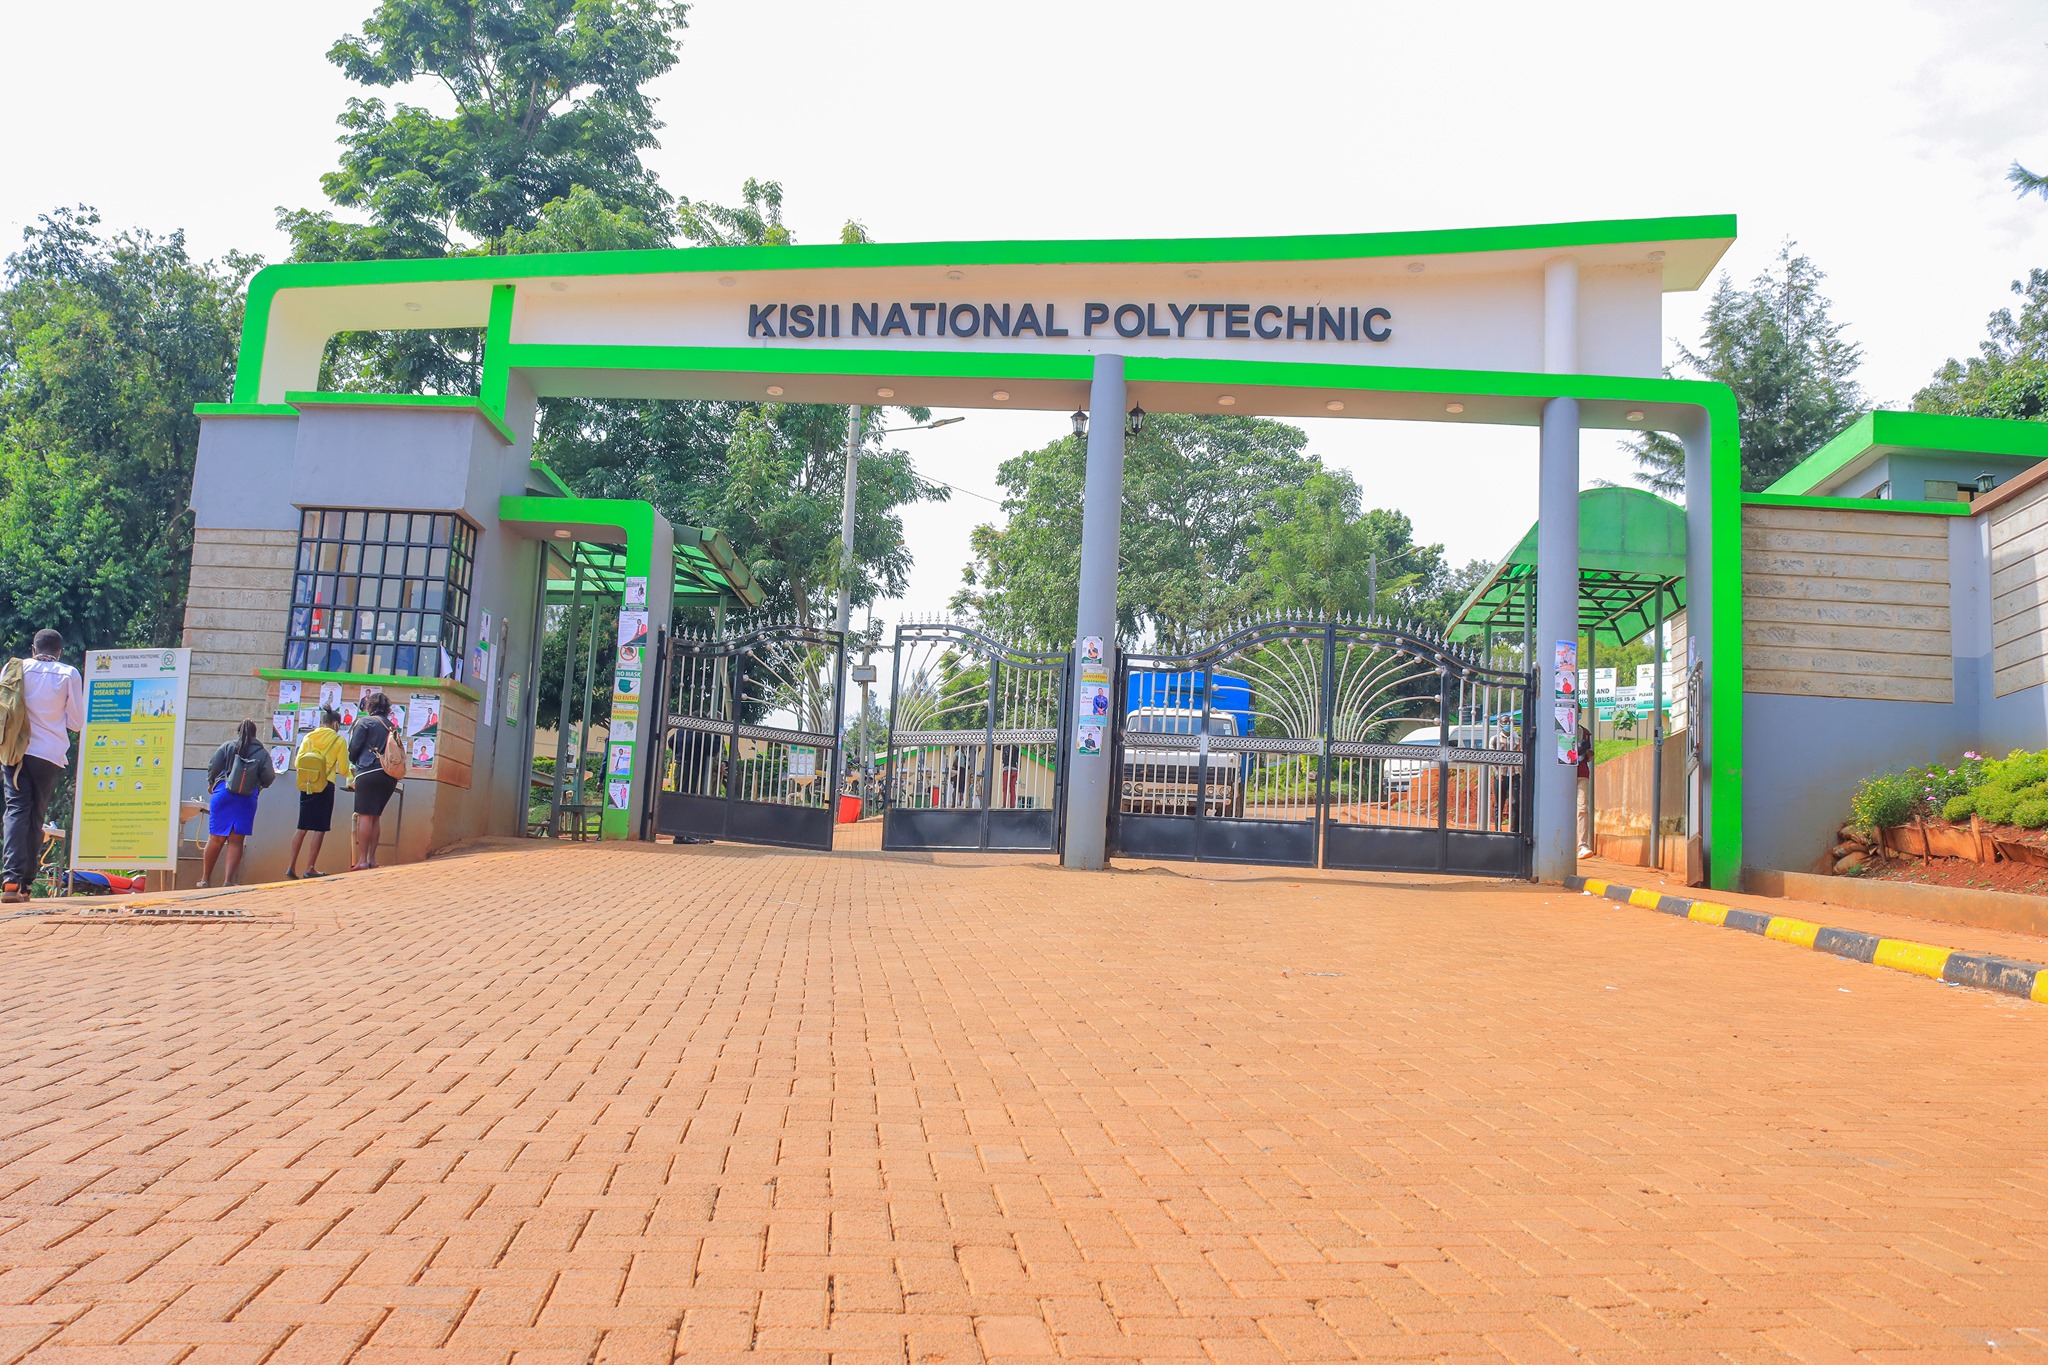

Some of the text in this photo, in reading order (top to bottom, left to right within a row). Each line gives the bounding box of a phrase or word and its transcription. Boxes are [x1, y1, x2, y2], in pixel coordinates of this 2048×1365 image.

[748, 302, 1392, 342] KISII NATIONAL POLYTECHNIC
